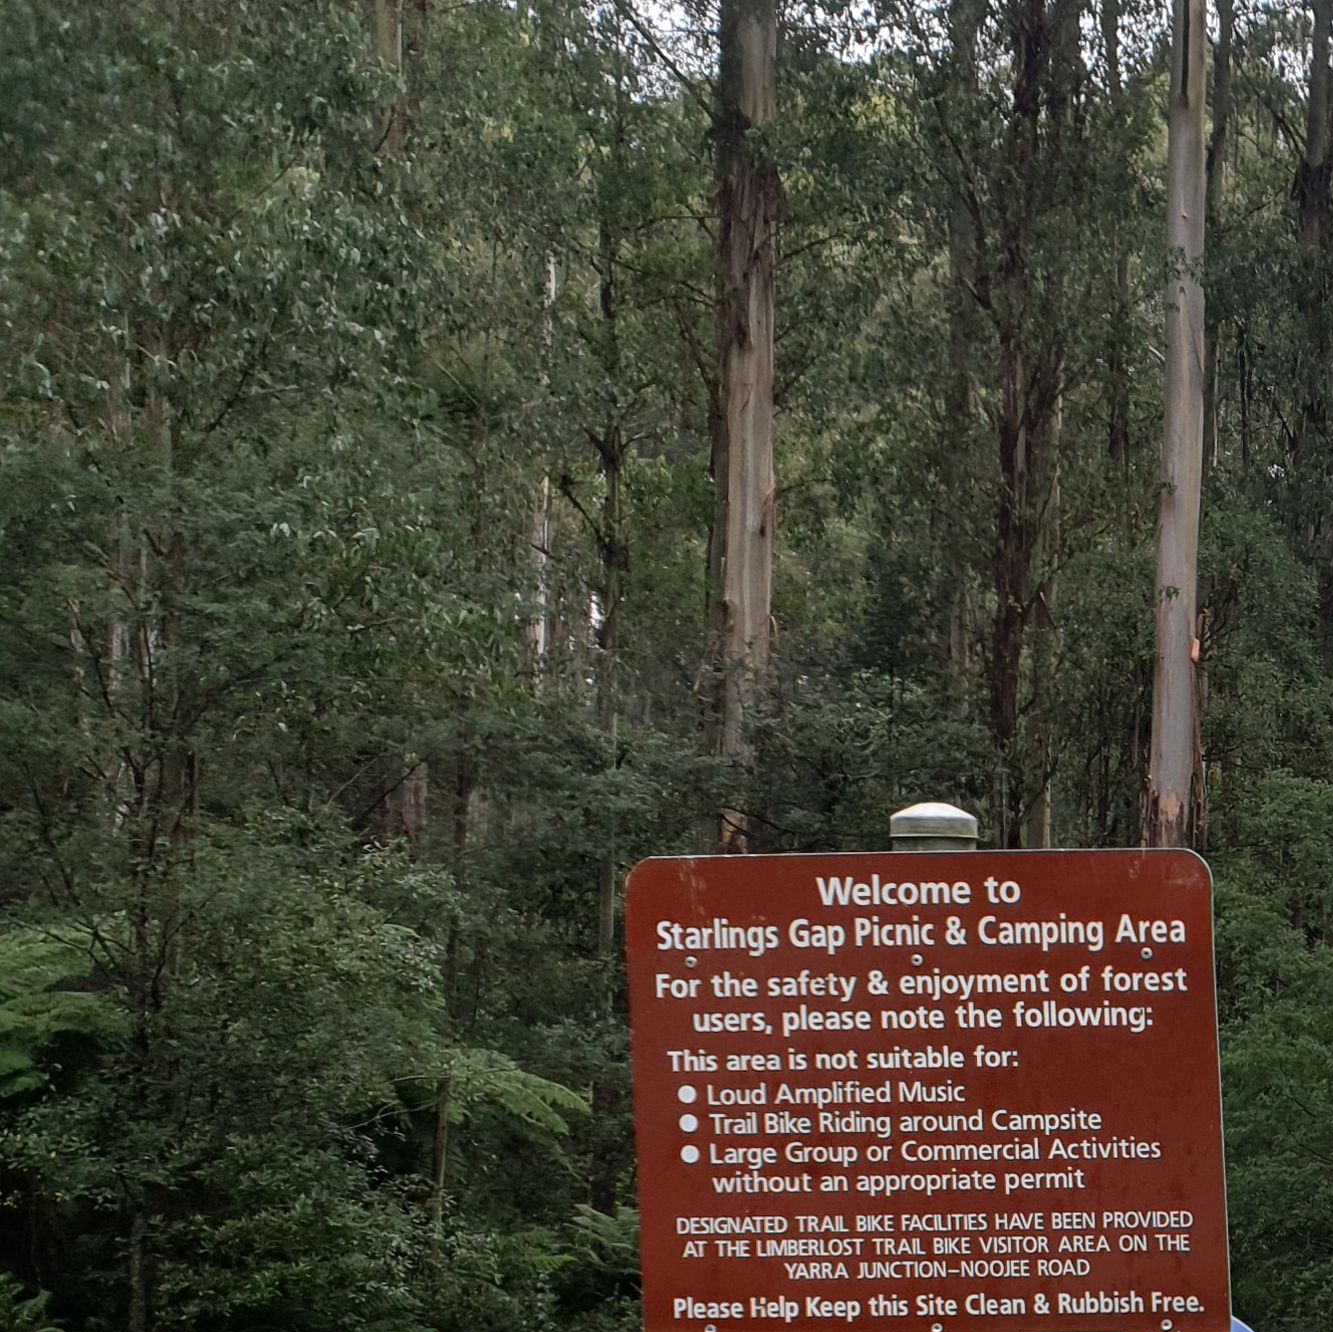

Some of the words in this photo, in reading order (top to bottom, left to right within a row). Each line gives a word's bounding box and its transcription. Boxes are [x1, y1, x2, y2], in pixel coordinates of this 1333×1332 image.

[815, 873, 971, 906] Welcome
[983, 876, 1021, 904] to
[656, 917, 779, 957] Starlings
[789, 918, 846, 955] Gap
[854, 915, 935, 947] Picnic
[945, 915, 967, 946] &
[978, 912, 1104, 952] Camping
[1115, 914, 1186, 943] Area
[655, 973, 702, 999] For
[710, 970, 758, 998] the
[767, 969, 857, 1002] safety
[867, 969, 889, 995] &
[899, 967, 1050, 1001] enjoyment
[1060, 965, 1090, 993] of
[1101, 965, 1188, 992] forest
[693, 1012, 773, 1035] users,
[782, 1004, 872, 1037] please
[881, 1006, 945, 1029] note
[954, 1001, 1003, 1029] the
[1012, 1000, 1153, 1033] following:
[666, 1049, 718, 1072] This
[726, 1054, 782, 1071] area
[788, 1047, 808, 1070] is
[815, 1049, 859, 1070] not
[866, 1045, 965, 1069] suitable
[973, 1044, 1019, 1068] for:
[707, 1082, 767, 1106] Loud
[774, 1080, 891, 1110] Amplified
[898, 1079, 966, 1103] Music
[708, 1111, 758, 1135] Trail
[764, 1110, 812, 1134] Bike
[818, 1110, 891, 1139] Riding
[899, 1108, 984, 1132] around
[991, 1107, 1102, 1136] Campsite
[710, 1143, 777, 1170] Large
[785, 1141, 858, 1168] Group
[866, 1145, 893, 1162] or
[901, 1137, 1040, 1162] Commercial
[1048, 1135, 1161, 1160] Activities
[712, 1170, 813, 1193] without
[819, 1175, 849, 1192] an
[856, 1167, 997, 1197] appropriate
[1004, 1166, 1085, 1195] permit
[676, 1216, 788, 1235] DESIGNATED
[794, 1215, 850, 1233] TRAIL
[856, 1214, 895, 1232] BIKE
[901, 1213, 988, 1232] FACILITIES
[995, 1212, 1045, 1230] HAVE
[1051, 1212, 1096, 1230] BEEN
[1102, 1210, 1194, 1229] PROVIDED
[682, 1240, 708, 1258] AT
[714, 1239, 751, 1258] THE
[756, 1238, 864, 1257] LIMBERLOST
[871, 1237, 927, 1255] TRAIL
[933, 1236, 972, 1255] BIKE
[978, 1235, 1050, 1254] VISITOR
[1058, 1235, 1111, 1253] AREA
[1118, 1234, 1147, 1252] ON
[1154, 1234, 1191, 1251] THE
[783, 1262, 849, 1280] YARRA
[1037, 1258, 1091, 1277] ROAD
[673, 1296, 744, 1319] Please
[750, 1295, 800, 1323] Help
[805, 1296, 861, 1322] Keep
[868, 1294, 909, 1317] this
[916, 1293, 958, 1316] Site
[965, 1292, 1026, 1316] Clean
[1033, 1293, 1050, 1315] &
[1058, 1290, 1144, 1314] Rubbish
[1151, 1291, 1205, 1313] Free.
